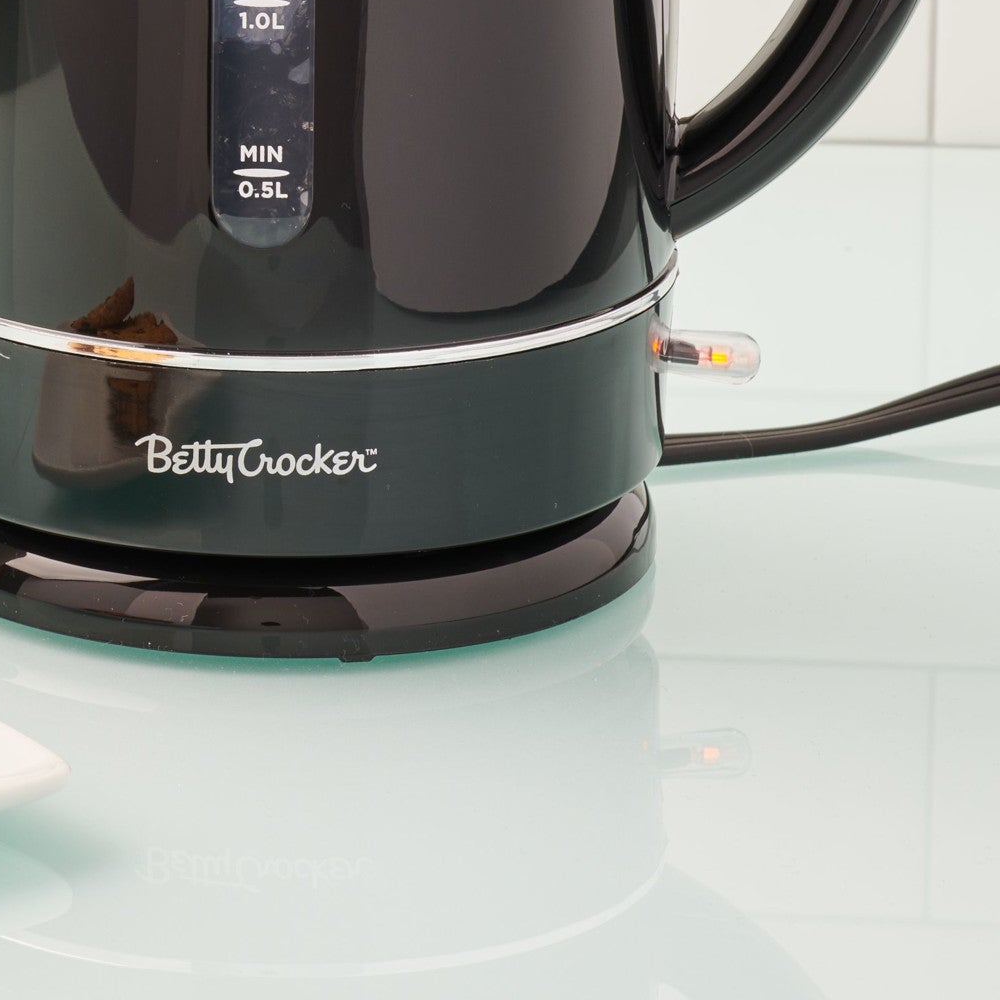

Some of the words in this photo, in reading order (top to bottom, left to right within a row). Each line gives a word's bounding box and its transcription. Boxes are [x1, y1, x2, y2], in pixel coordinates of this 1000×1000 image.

[238, 12, 285, 30] 1.0L
[239, 145, 283, 163] MIN
[238, 180, 289, 199] 0.5L
[134, 433, 234, 484] Betty
